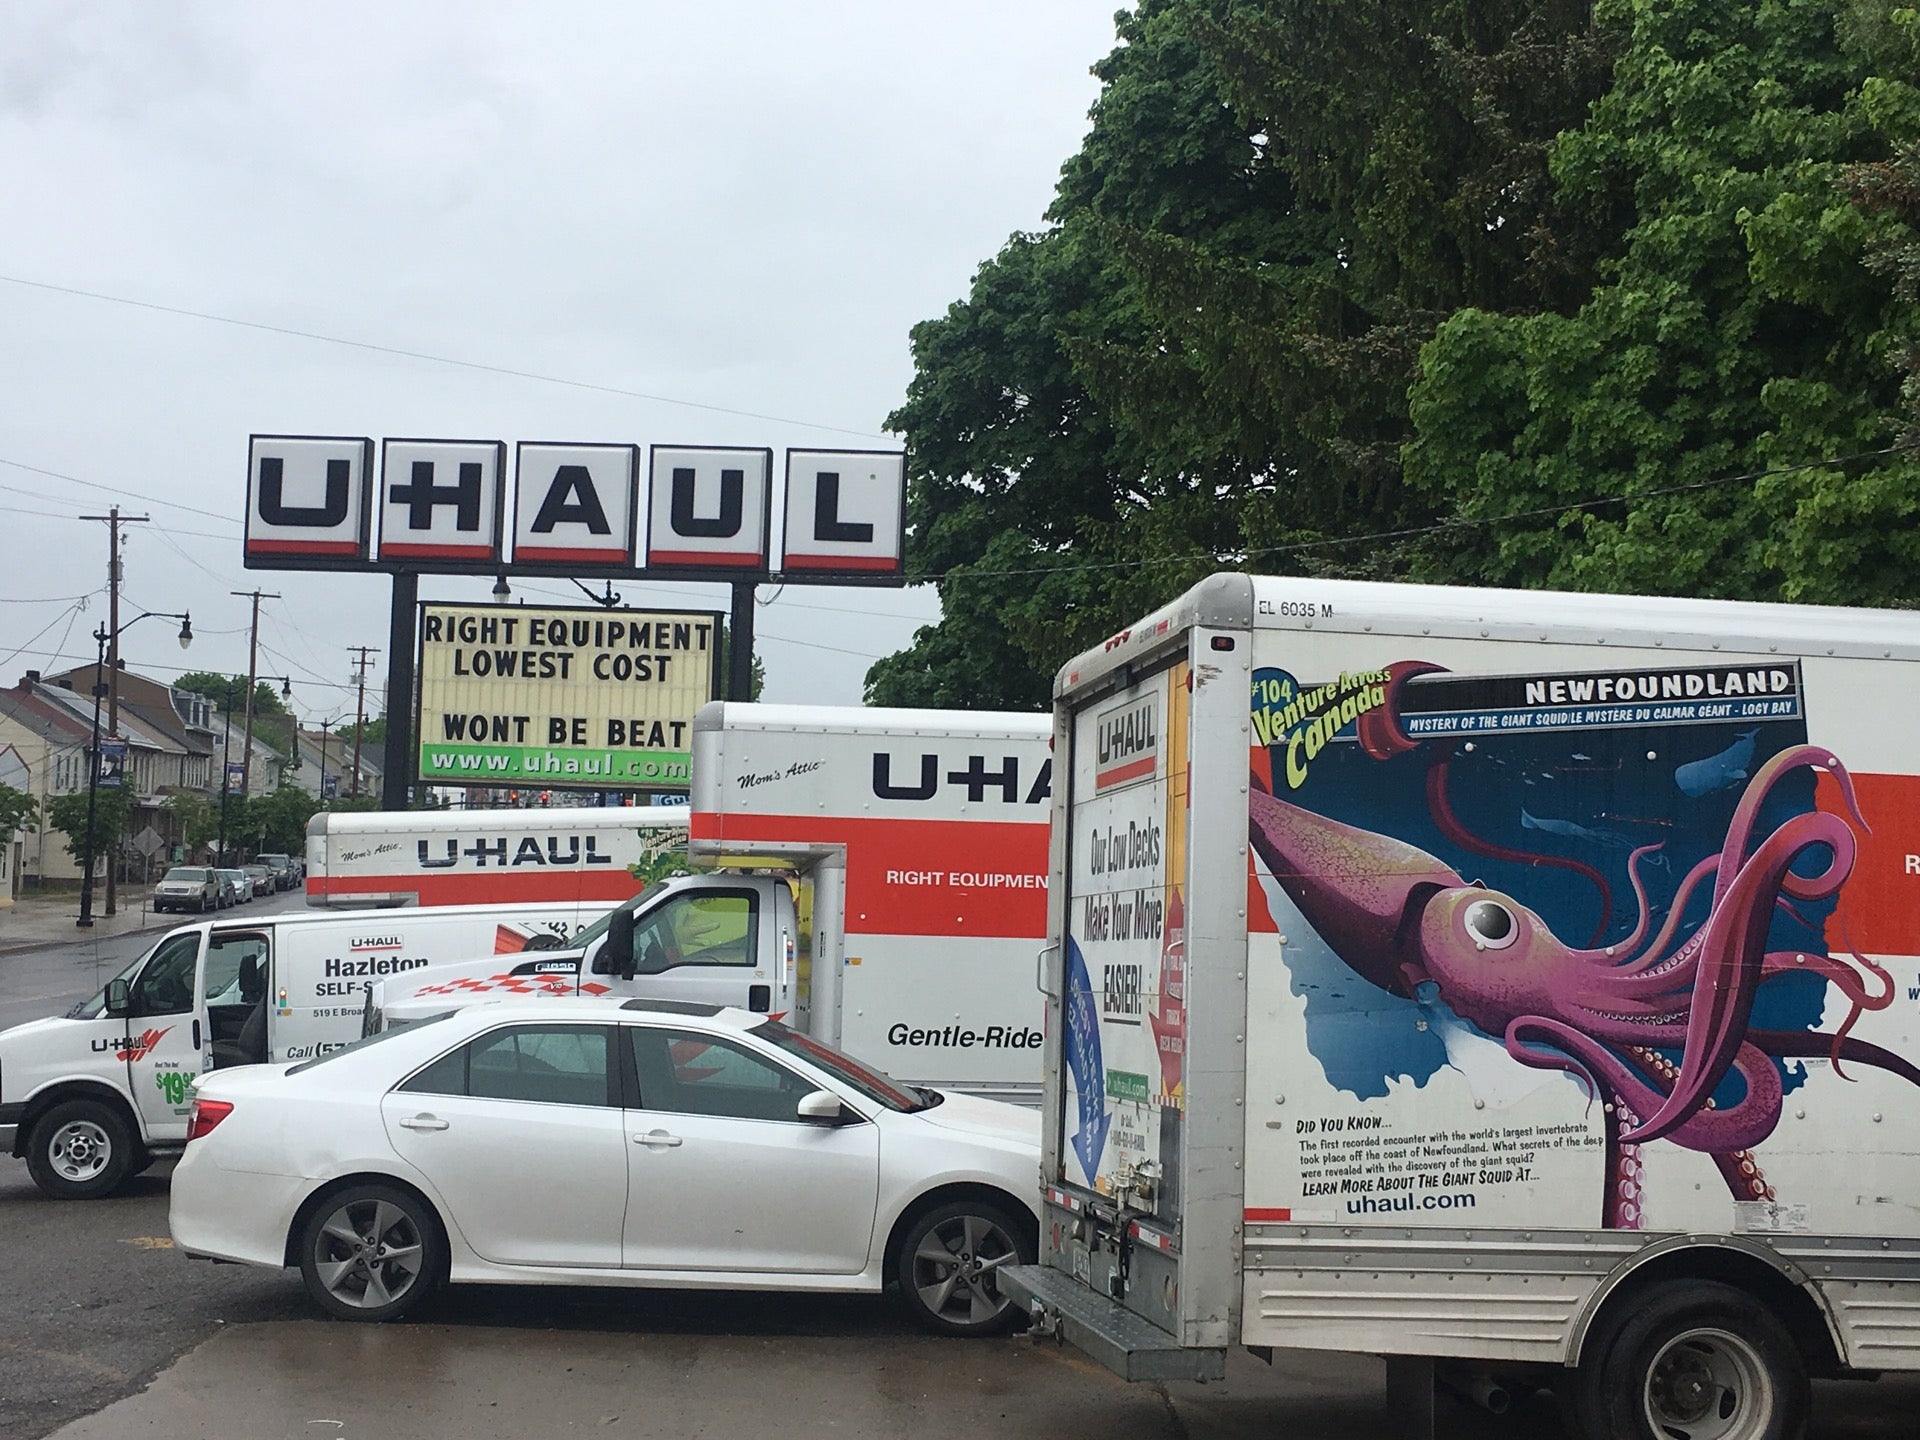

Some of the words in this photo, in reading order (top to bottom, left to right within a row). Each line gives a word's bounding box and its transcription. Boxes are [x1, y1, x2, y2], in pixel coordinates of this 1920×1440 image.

[1259, 600, 1276, 615] EL
[1280, 601, 1316, 617] 6035
[1321, 604, 1333, 618] M
[425, 615, 519, 644] RIGHT
[529, 619, 712, 650] EQUIPMENT
[454, 649, 574, 680] LOWEST
[593, 654, 672, 682] COST
[1251, 678, 1293, 704] #104
[1525, 670, 1789, 705] NEWFOUNDLAND
[1251, 683, 1337, 748] Venture
[1339, 670, 1392, 695] Across
[1409, 717, 1458, 731] MYSTERY
[1462, 716, 1476, 730] OF
[1478, 716, 1498, 728] THE
[1501, 714, 1533, 727] GIANT
[1585, 707, 1633, 723] MYSTÈRE
[1636, 708, 1650, 720] DU
[1653, 706, 1695, 719] CALMAR
[1698, 703, 1732, 718] GÉANT
[1742, 702, 1769, 715] LOGY
[1771, 701, 1792, 714] BAY
[444, 714, 530, 743] WONT
[549, 717, 587, 745] BE
[608, 720, 687, 748] BEAT
[1099, 705, 1155, 764] U-HAUL
[1286, 684, 1386, 789] Canada
[431, 752, 688, 778] www.uhaul.com
[737, 769, 781, 789] Mom's
[785, 762, 820, 778] Attic
[418, 836, 612, 868] U-HAUL
[1091, 828, 1107, 876] Our
[1108, 826, 1128, 872] Low
[1129, 816, 1160, 869] Decks
[886, 870, 944, 886] RIGHT
[949, 872, 1049, 889] EQUIPMEN
[1084, 896, 1109, 942] Make
[1110, 892, 1133, 941] Your
[1133, 890, 1163, 940] Move
[351, 936, 402, 947] U-HAUL
[325, 956, 429, 977] Hazleton
[1104, 964, 1142, 1015] EASIER!
[313, 1009, 331, 1018] 519
[333, 1009, 339, 1017] E
[92, 1036, 147, 1052] U-HAUL
[888, 1022, 1044, 1049] Gentle-Ride
[287, 1046, 314, 1059] Call
[1296, 1119, 1316, 1134] DID
[1320, 1117, 1344, 1132] YOU
[1299, 1140, 1317, 1151] The
[1320, 1139, 1339, 1150] first
[1342, 1136, 1380, 1148] recorded
[1383, 1134, 1426, 1145] encounter
[1429, 1131, 1449, 1142] with
[1452, 1130, 1466, 1141] the
[1469, 1128, 1500, 1140] world's
[1503, 1126, 1533, 1139] largest
[1536, 1123, 1588, 1135] invertebrate
[1300, 1154, 1320, 1165] took
[1323, 1152, 1346, 1165] place
[1350, 1151, 1363, 1162] off
[1366, 1150, 1380, 1160] the
[1383, 1149, 1407, 1159] coast
[1410, 1147, 1420, 1157] of
[1423, 1143, 1489, 1156] Newfoundland.
[1492, 1140, 1517, 1152] What
[1520, 1139, 1550, 1150] secrets
[1553, 1137, 1563, 1148] of
[1566, 1136, 1580, 1147] the
[1583, 1135, 1603, 1147] deep
[1301, 1169, 1322, 1179] were
[1325, 1165, 1362, 1177] revealed
[1365, 1163, 1385, 1174] with
[1388, 1162, 1403, 1173] the
[1405, 1160, 1446, 1172] discovery
[1450, 1157, 1460, 1168] of
[1463, 1156, 1477, 1167] the
[1480, 1154, 1502, 1168] giant
[1505, 1152, 1535, 1166] squid?
[1302, 1182, 1338, 1197] LEARN
[1340, 1179, 1373, 1194] MORE
[1376, 1176, 1415, 1191] ABOUT
[1418, 1174, 1438, 1188] THE
[1442, 1172, 1476, 1186] GIANT
[1478, 1170, 1513, 1184] SQUID
[1346, 1191, 1476, 1214] uhaul.com
